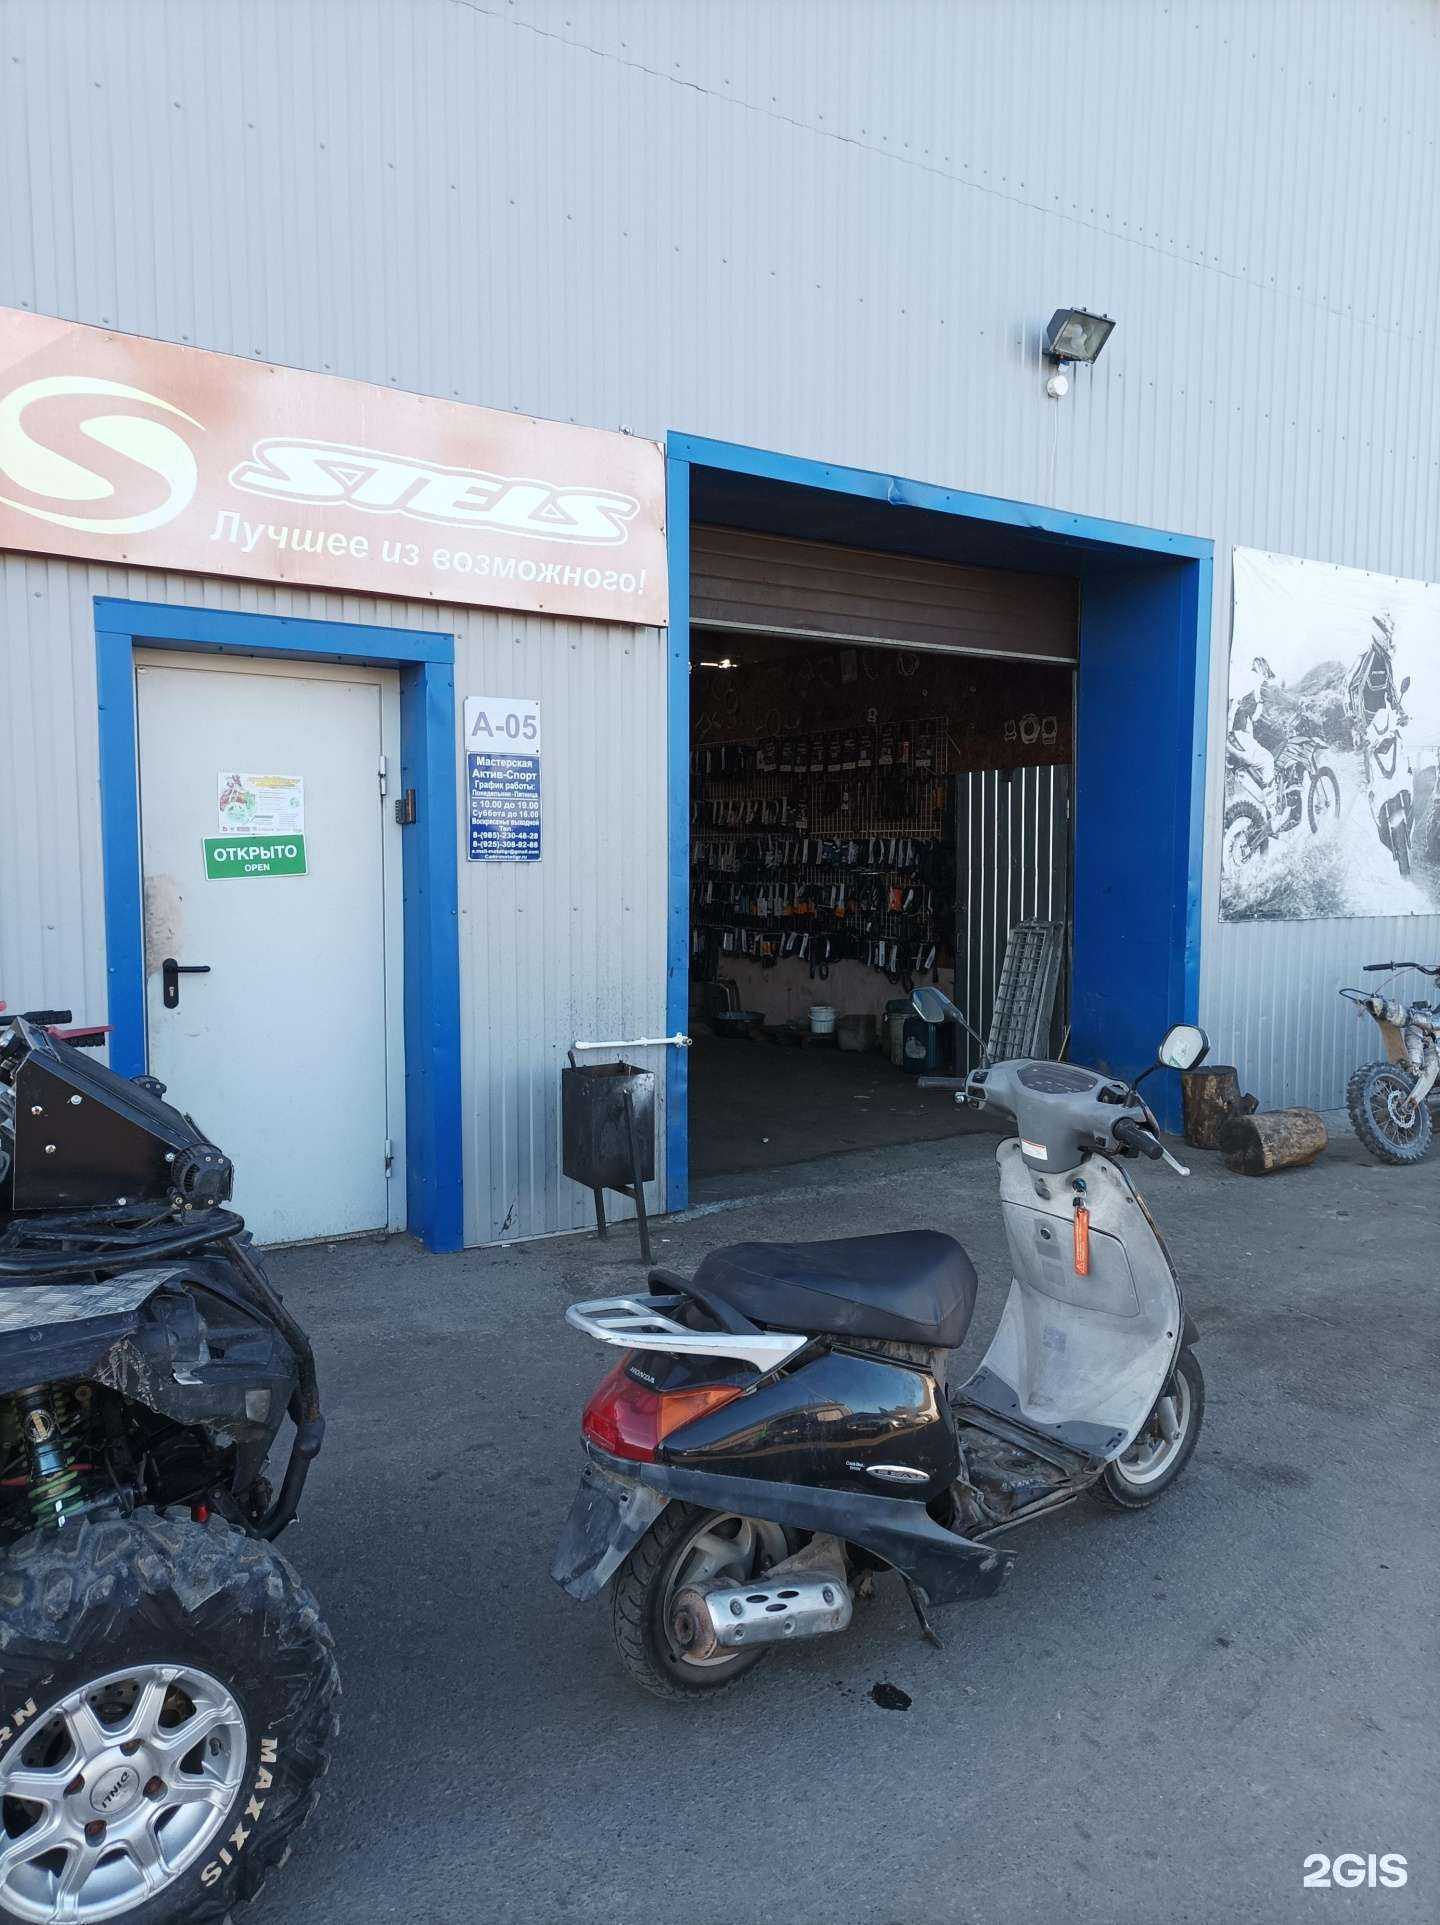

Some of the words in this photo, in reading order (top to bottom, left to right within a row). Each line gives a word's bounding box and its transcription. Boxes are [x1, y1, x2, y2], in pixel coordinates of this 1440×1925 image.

[229, 437, 640, 546] STELS
[209, 509, 369, 558] Лучшее
[382, 539, 420, 566] из
[431, 548, 648, 595] возможного!
[476, 756, 533, 769] Мастерская
[472, 768, 537, 782] Актив-Спорт
[474, 780, 504, 790] График
[480, 800, 502, 809] 10.00
[504, 801, 515, 810] до
[472, 809, 506, 818] Суббота
[213, 844, 298, 862] ОТКРЫТО
[244, 863, 271, 872] OPEN
[201, 1737, 278, 1887] MAXXIS
